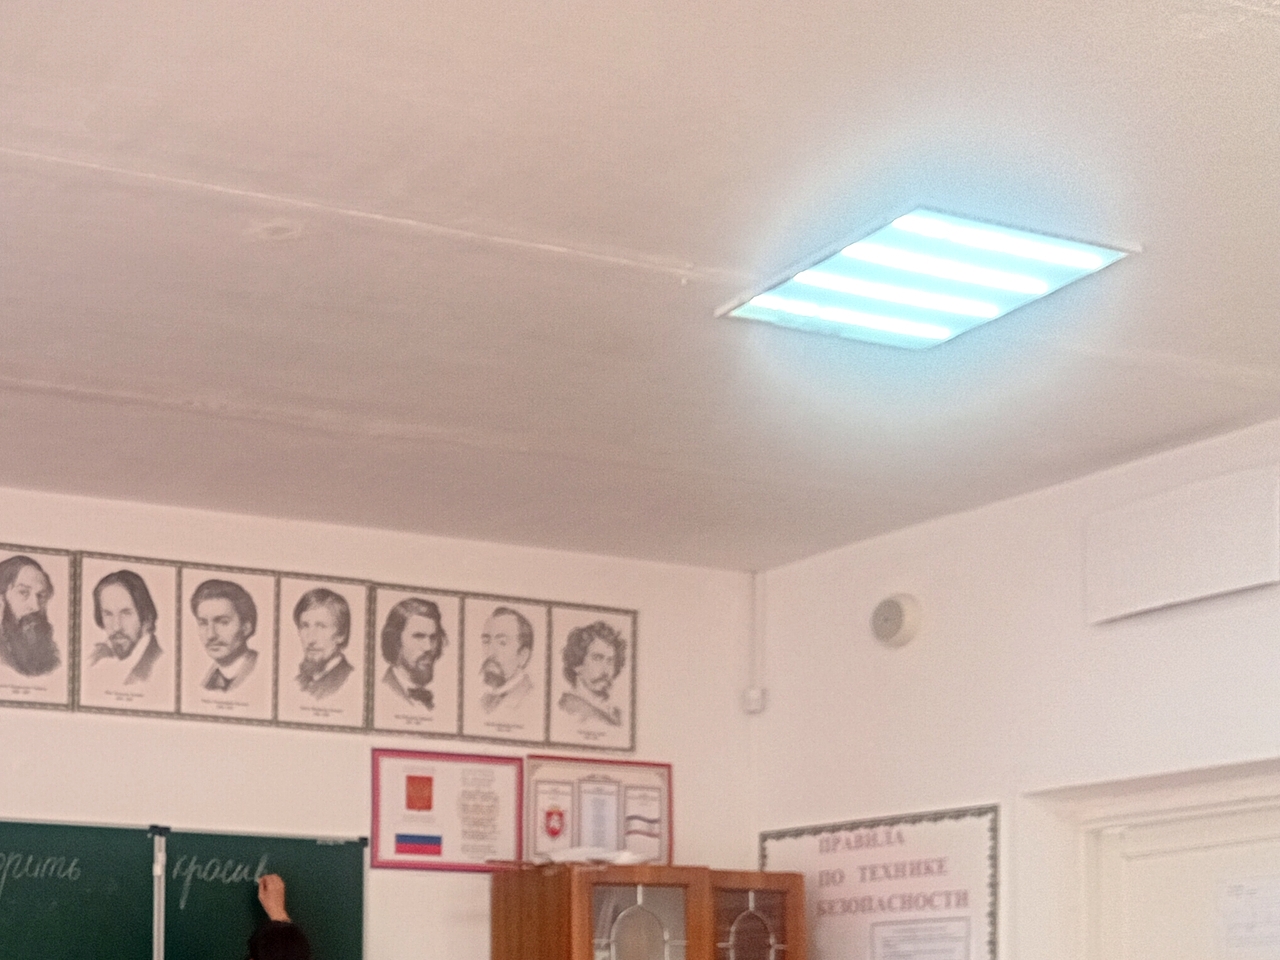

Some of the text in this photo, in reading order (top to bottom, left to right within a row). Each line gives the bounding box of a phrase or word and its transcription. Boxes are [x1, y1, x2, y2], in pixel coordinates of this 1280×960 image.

[818, 829, 906, 854] ПРАВИЛА
[817, 856, 949, 887] ПО ТЕХНИКЕ
[816, 889, 970, 916] БЕЗОПАСНОСТИ
